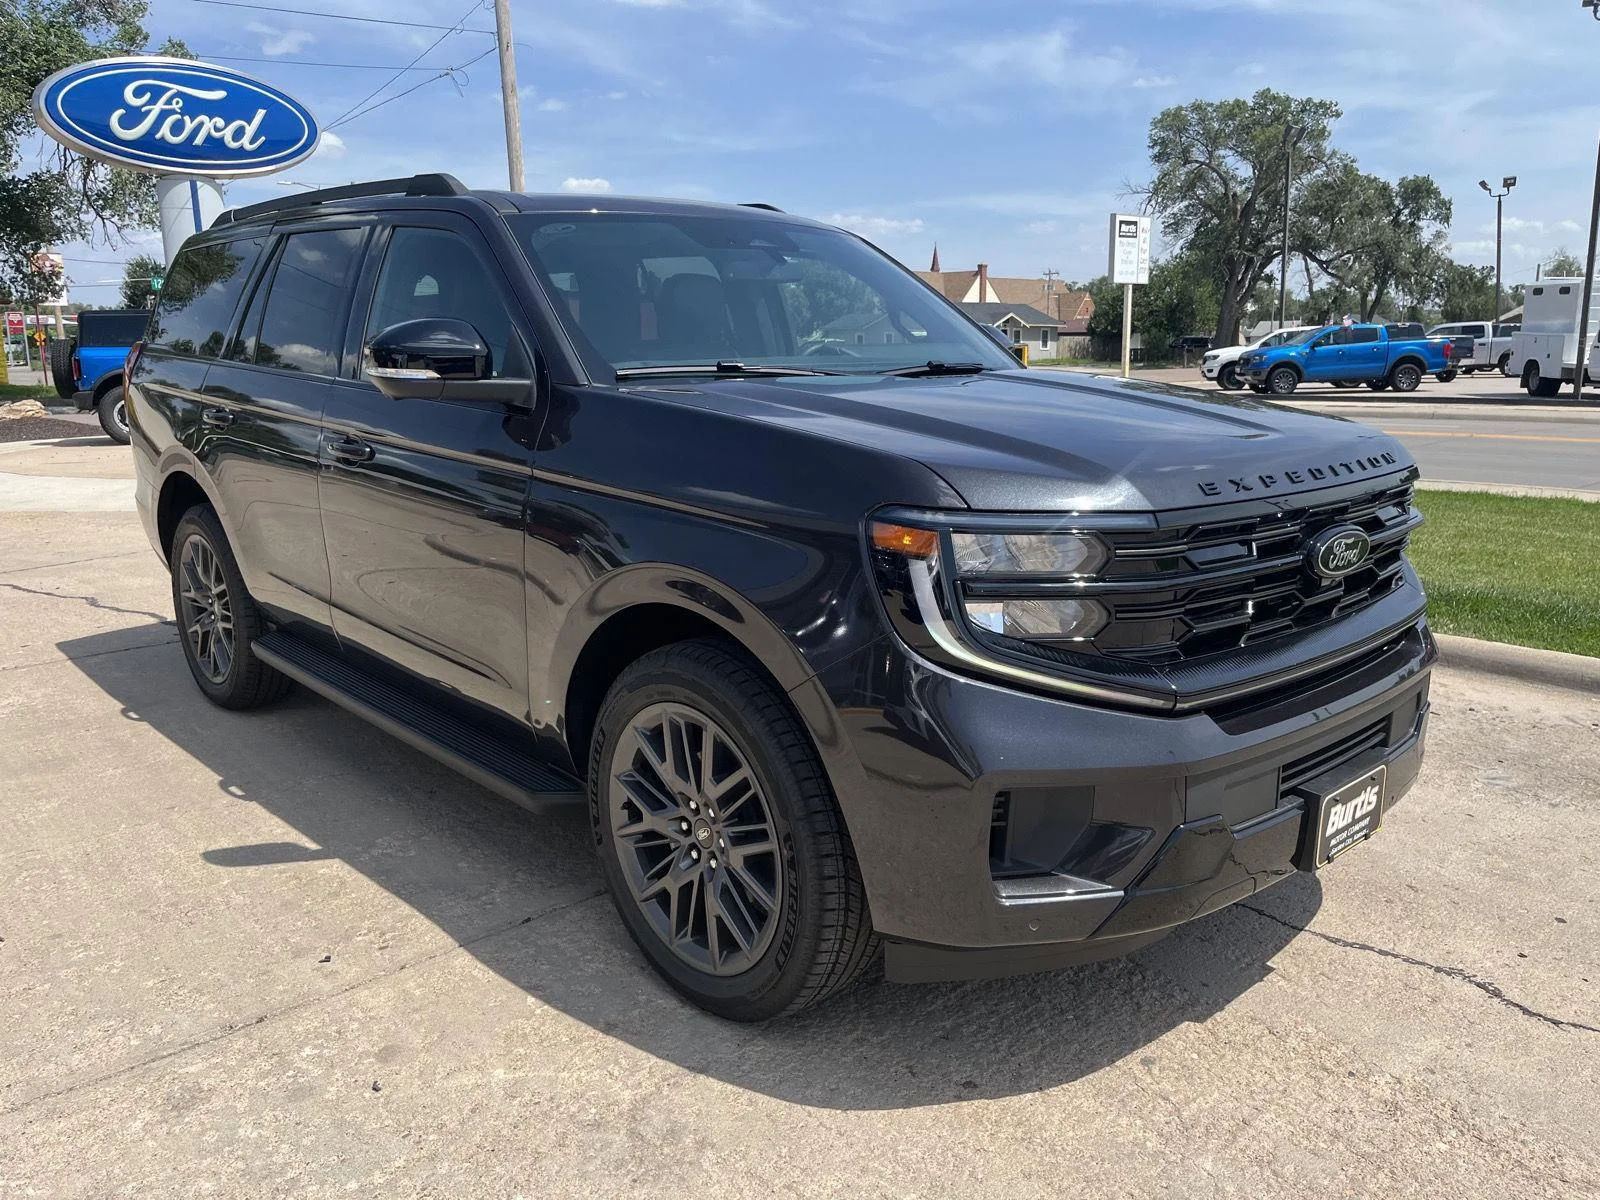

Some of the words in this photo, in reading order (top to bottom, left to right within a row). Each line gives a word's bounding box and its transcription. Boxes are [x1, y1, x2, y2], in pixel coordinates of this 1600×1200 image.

[109, 79, 267, 151] Ford
[1198, 452, 1396, 496] EXPEDITION
[1328, 537, 1362, 569] Ford
[1326, 785, 1380, 838] Burtis
[1330, 830, 1348, 848] MOTOR
[1347, 815, 1371, 836] COMPANY
